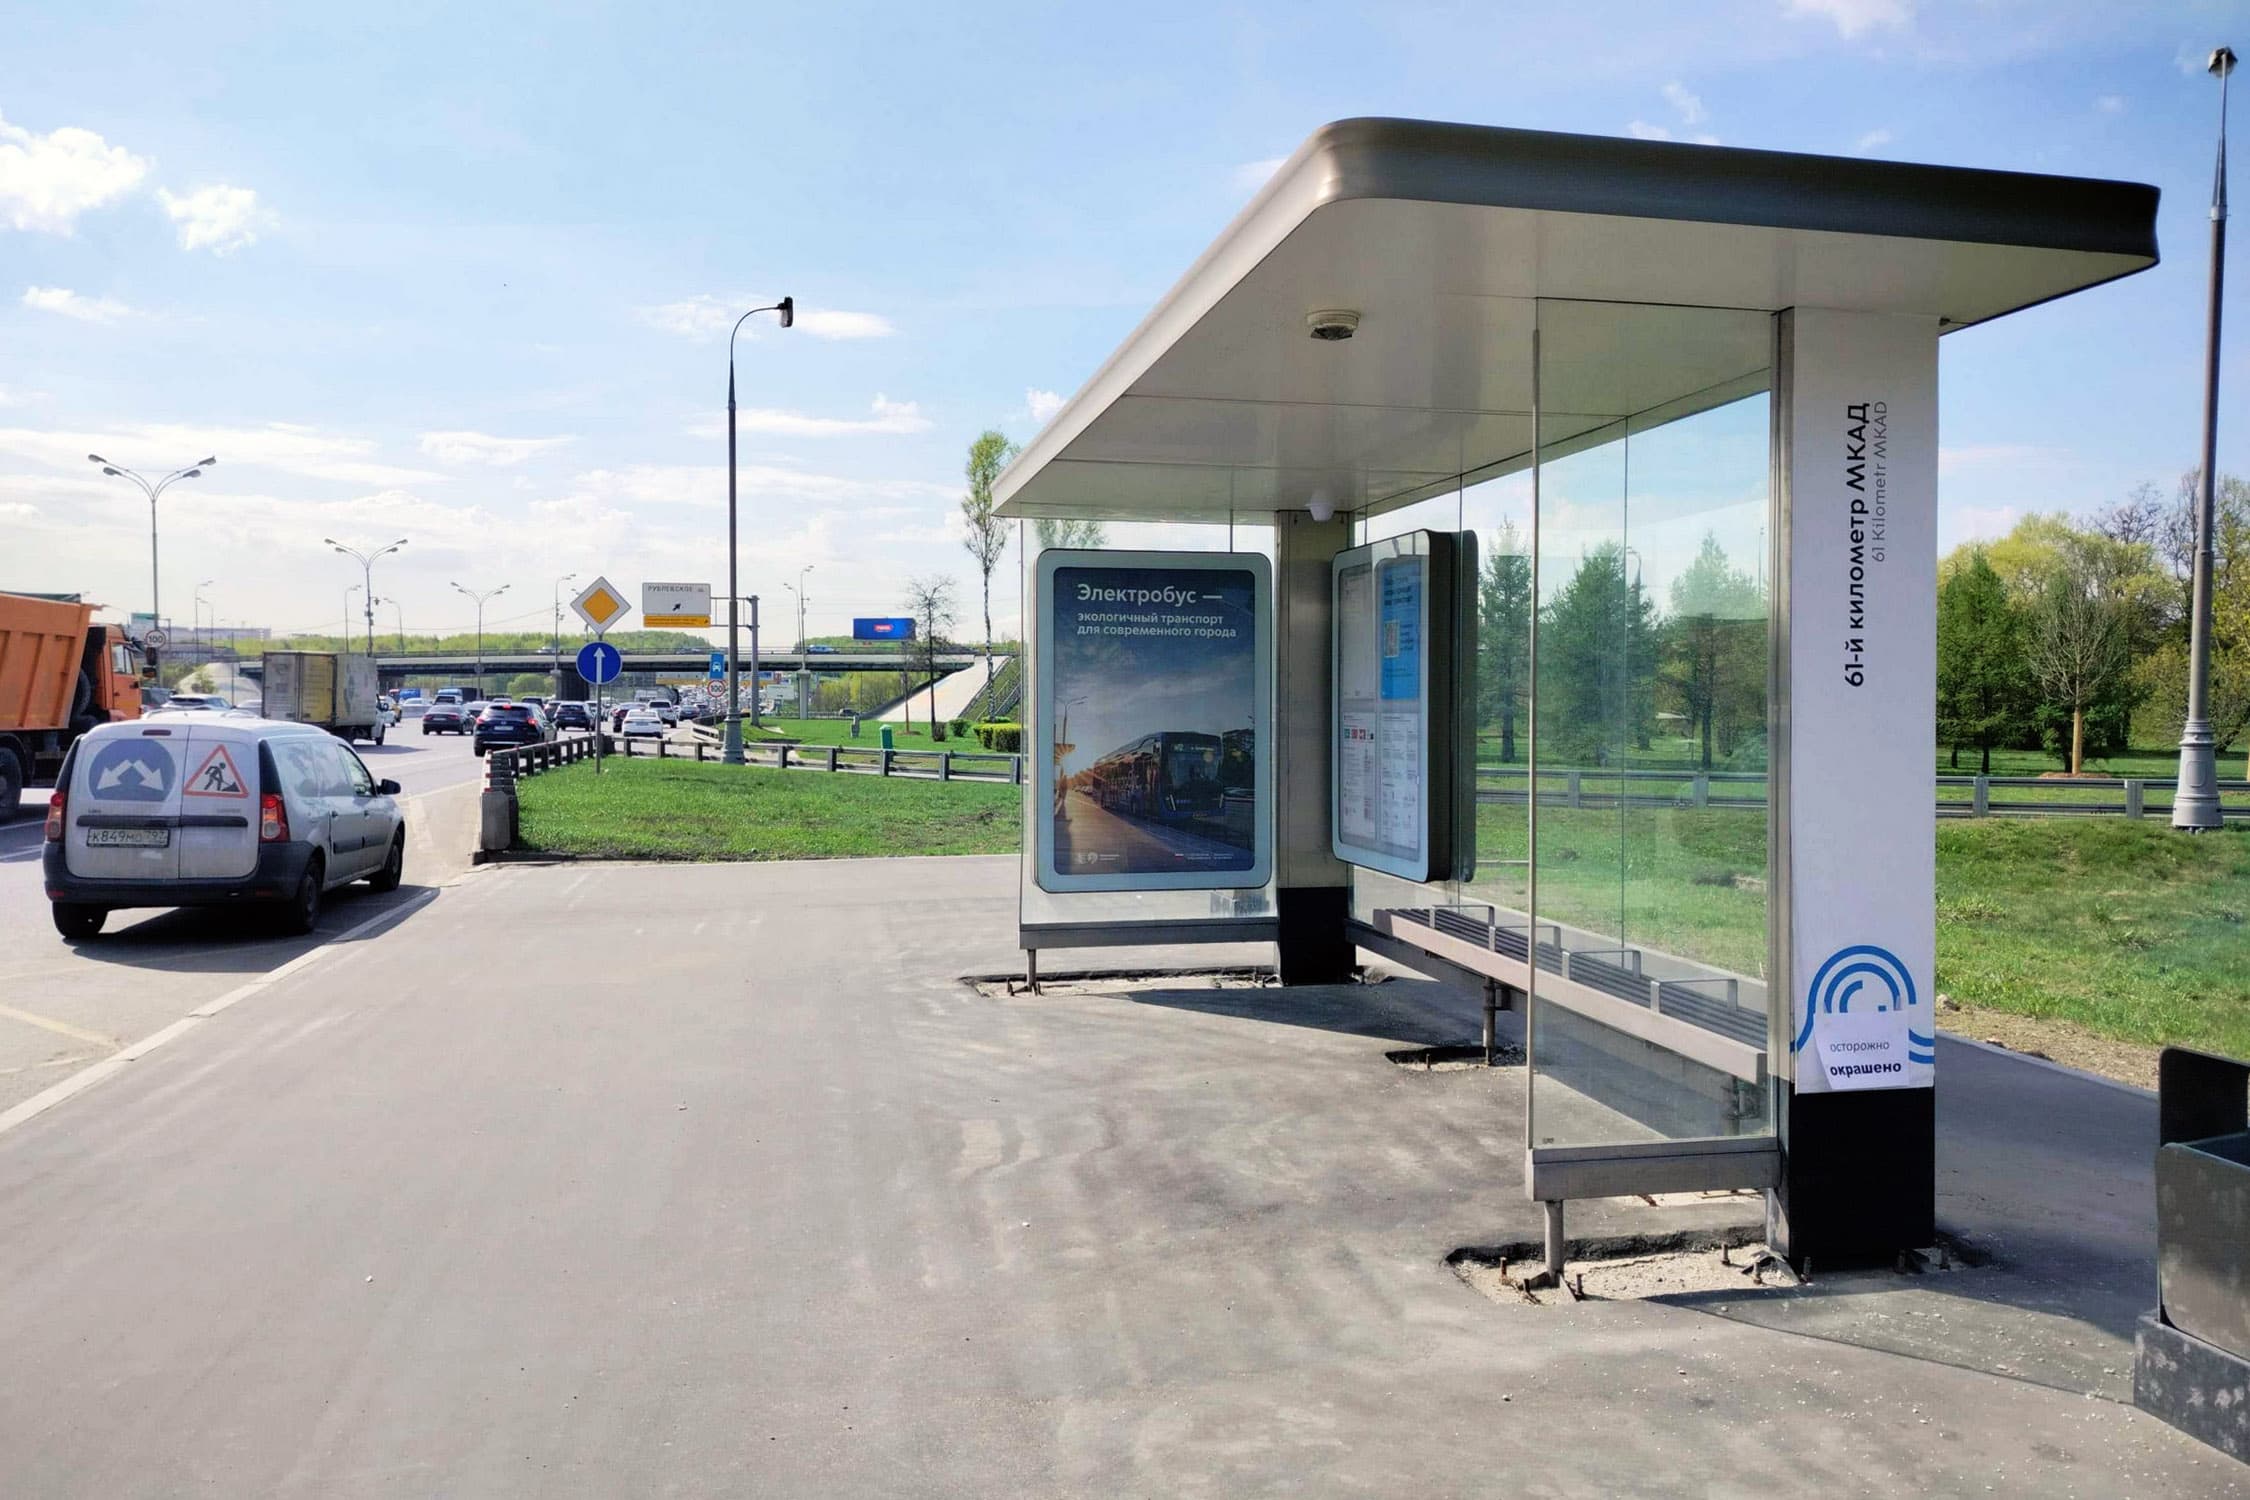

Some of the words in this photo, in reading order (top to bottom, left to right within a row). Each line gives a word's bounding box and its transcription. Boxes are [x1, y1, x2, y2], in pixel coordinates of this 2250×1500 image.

[1873, 401, 1888, 459] MKAD
[1846, 402, 1870, 491] МКАД
[1871, 463, 1885, 541] Kilometr
[1849, 498, 1869, 629] километр
[1871, 547, 1885, 562] 61
[1077, 583, 1196, 607] Электробус
[1077, 612, 1158, 623] экологичный
[1161, 614, 1224, 626] транспорт
[149, 635, 163, 643] 100
[1077, 625, 1100, 636] для
[1103, 625, 1191, 637] современного
[1194, 626, 1237, 638] города
[1844, 638, 1864, 688] 61-й
[1830, 1041, 1890, 1053] осторожно
[1830, 1062, 1901, 1078] окрашено
